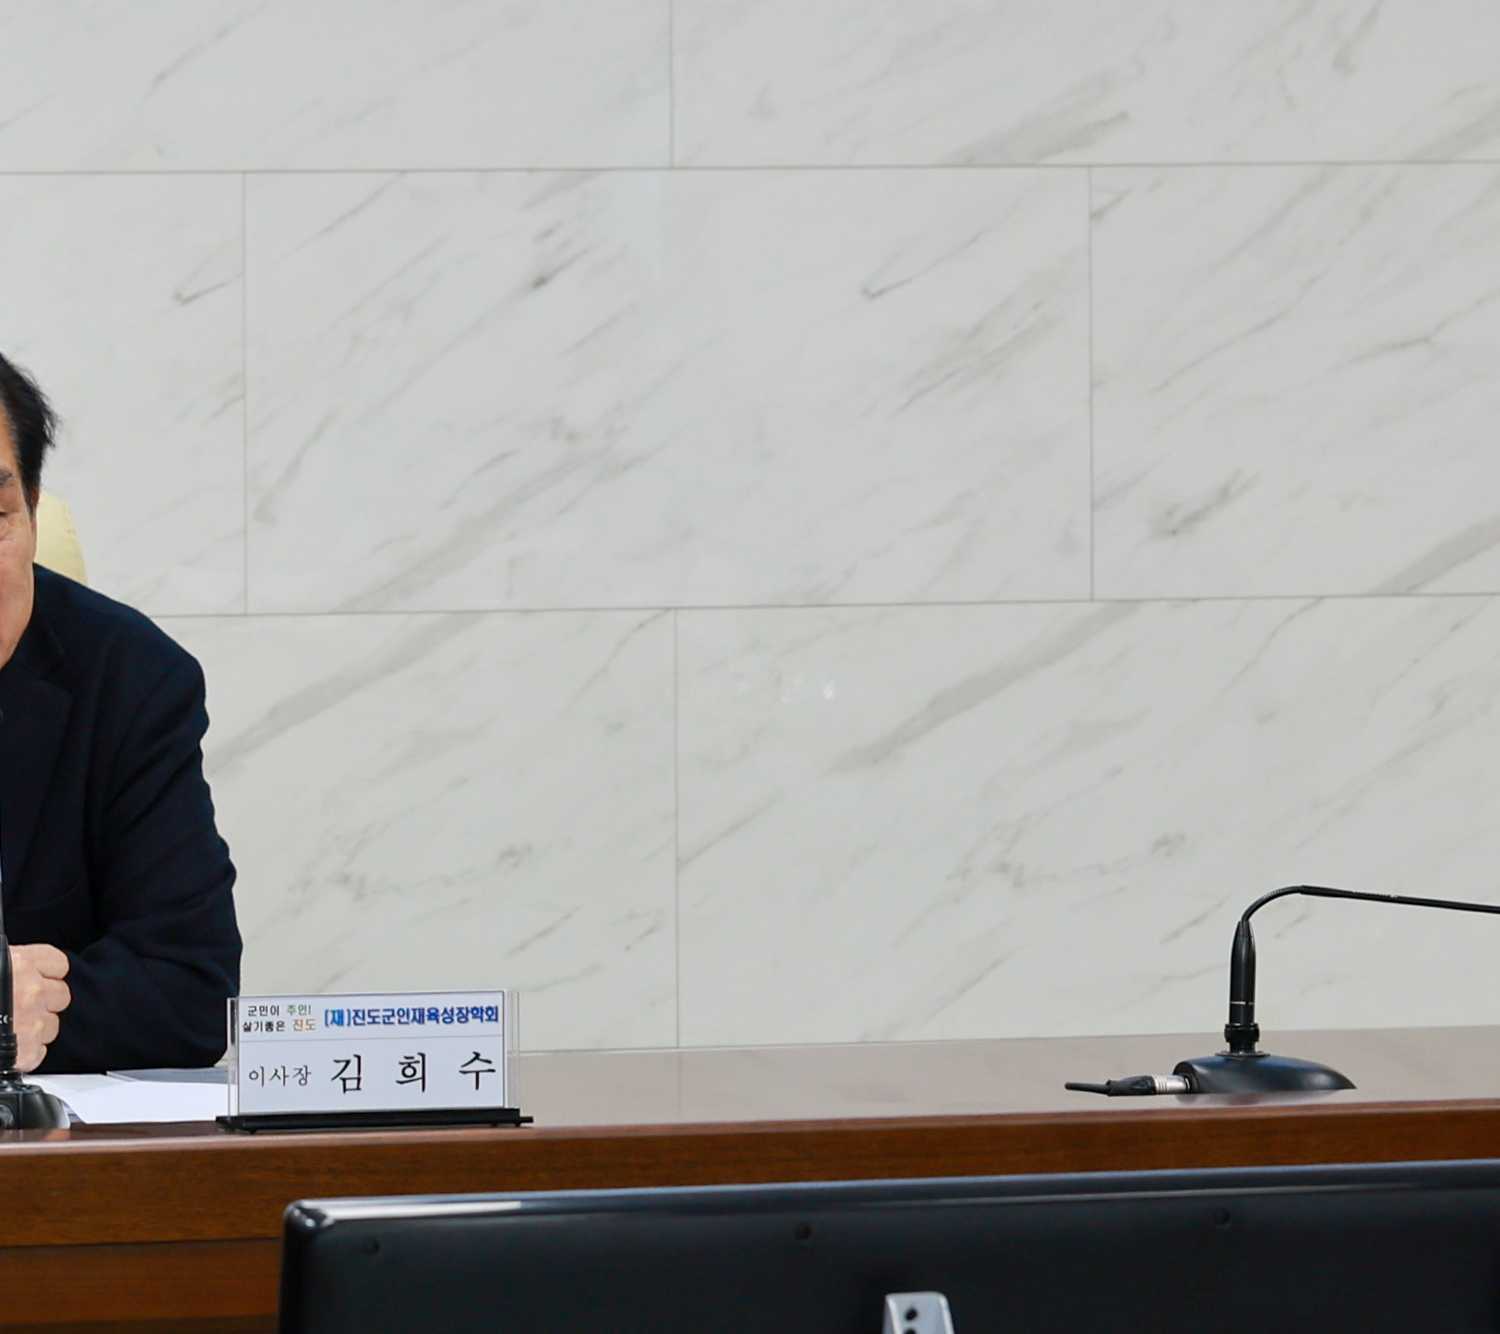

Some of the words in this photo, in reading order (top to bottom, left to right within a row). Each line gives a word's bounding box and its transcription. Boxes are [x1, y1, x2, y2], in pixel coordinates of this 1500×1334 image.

[247, 1005, 280, 1018] 군민이
[242, 1020, 286, 1033] 살기좋은
[291, 1018, 317, 1032] 진도
[248, 1064, 312, 1087] 이사장
